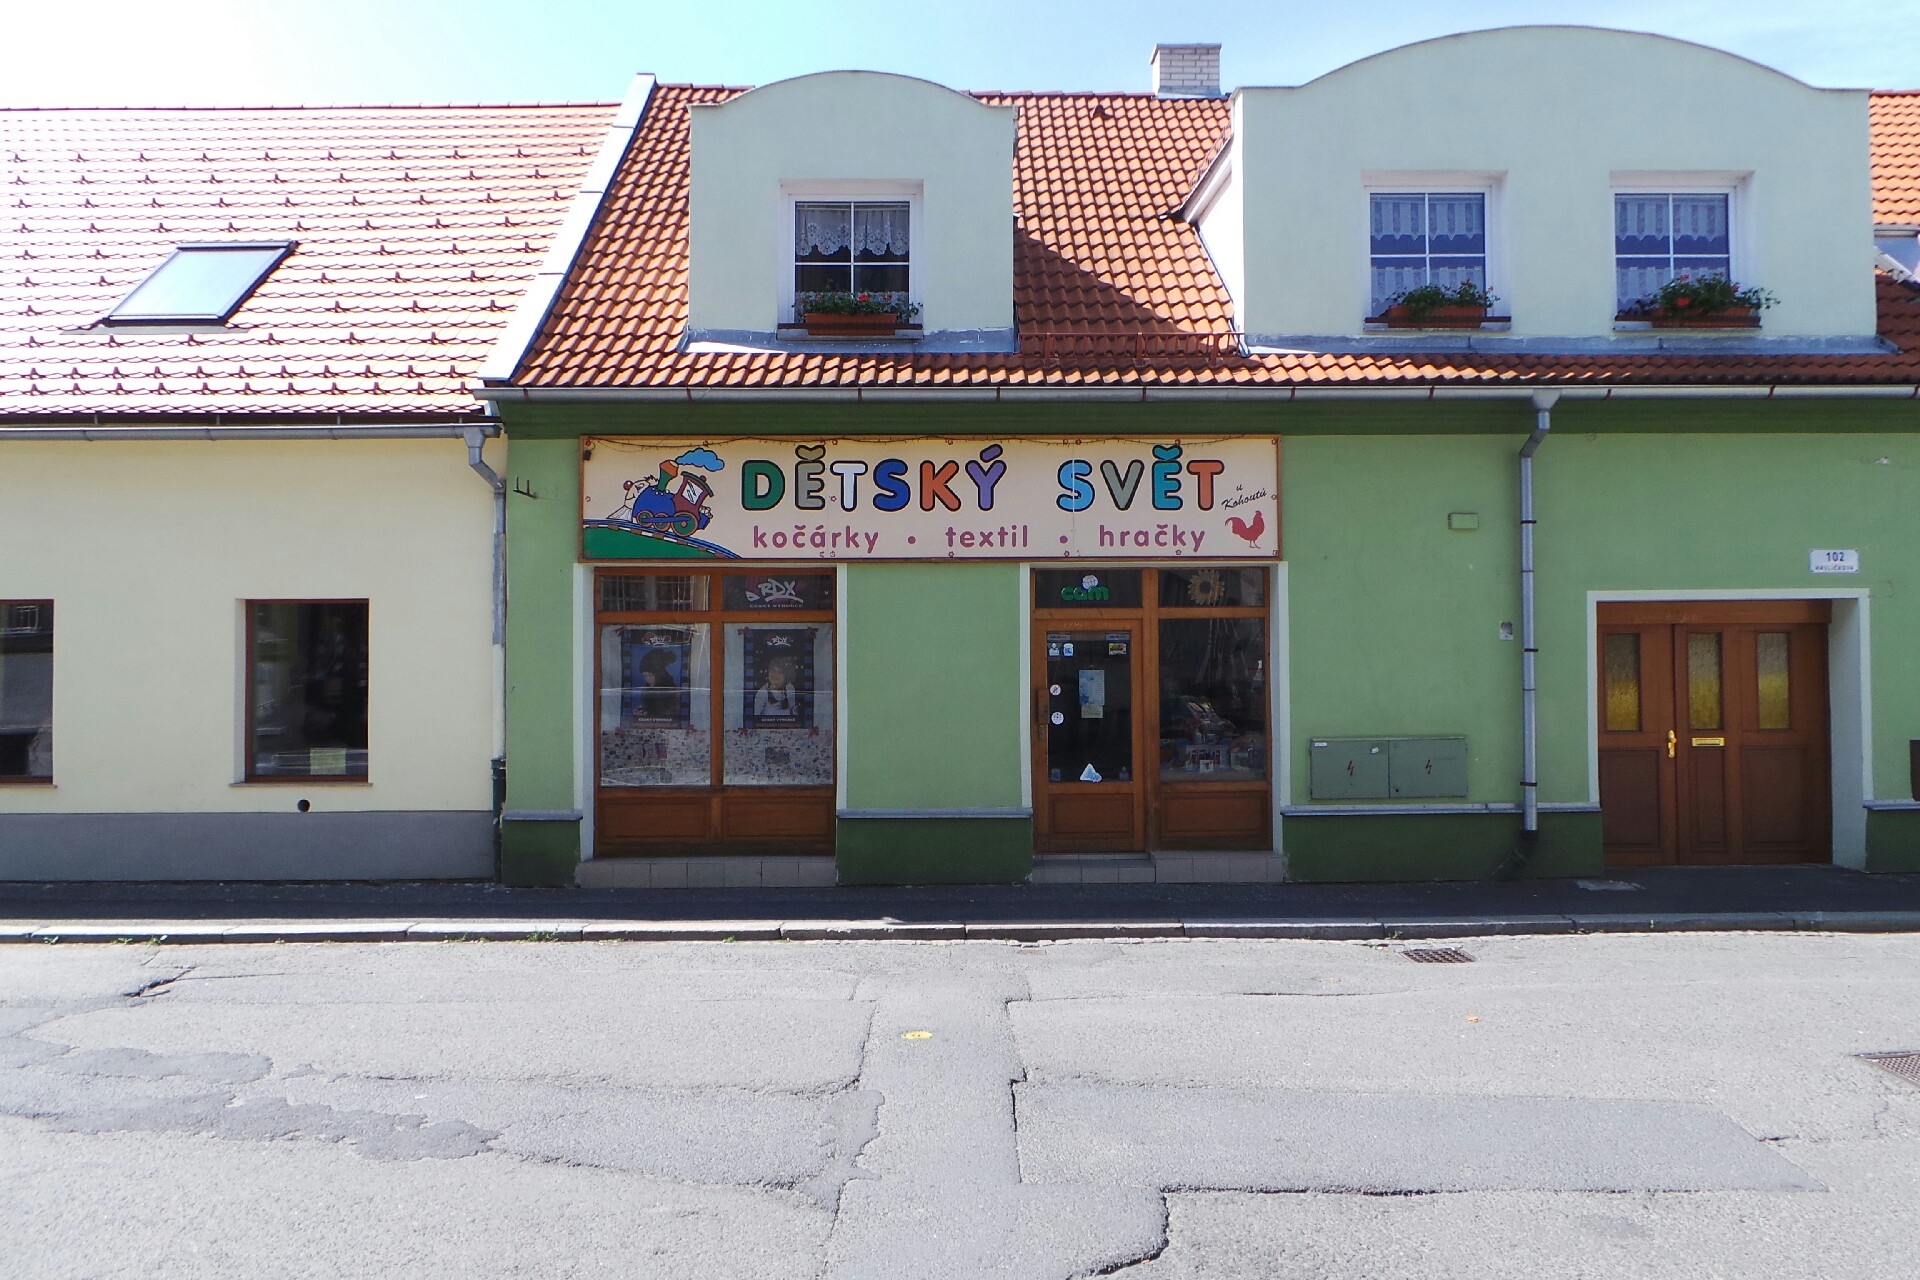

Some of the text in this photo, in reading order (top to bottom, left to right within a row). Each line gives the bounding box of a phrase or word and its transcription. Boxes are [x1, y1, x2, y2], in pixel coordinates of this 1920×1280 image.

[741, 444, 1225, 512] DĚTSKÝ SVĚT
[1221, 487, 1268, 511] Kohoutů
[753, 524, 1206, 554] kočárky textil hračky
[1825, 551, 1845, 562] 102
[757, 577, 799, 599] RDX
[1061, 586, 1110, 601] cam
